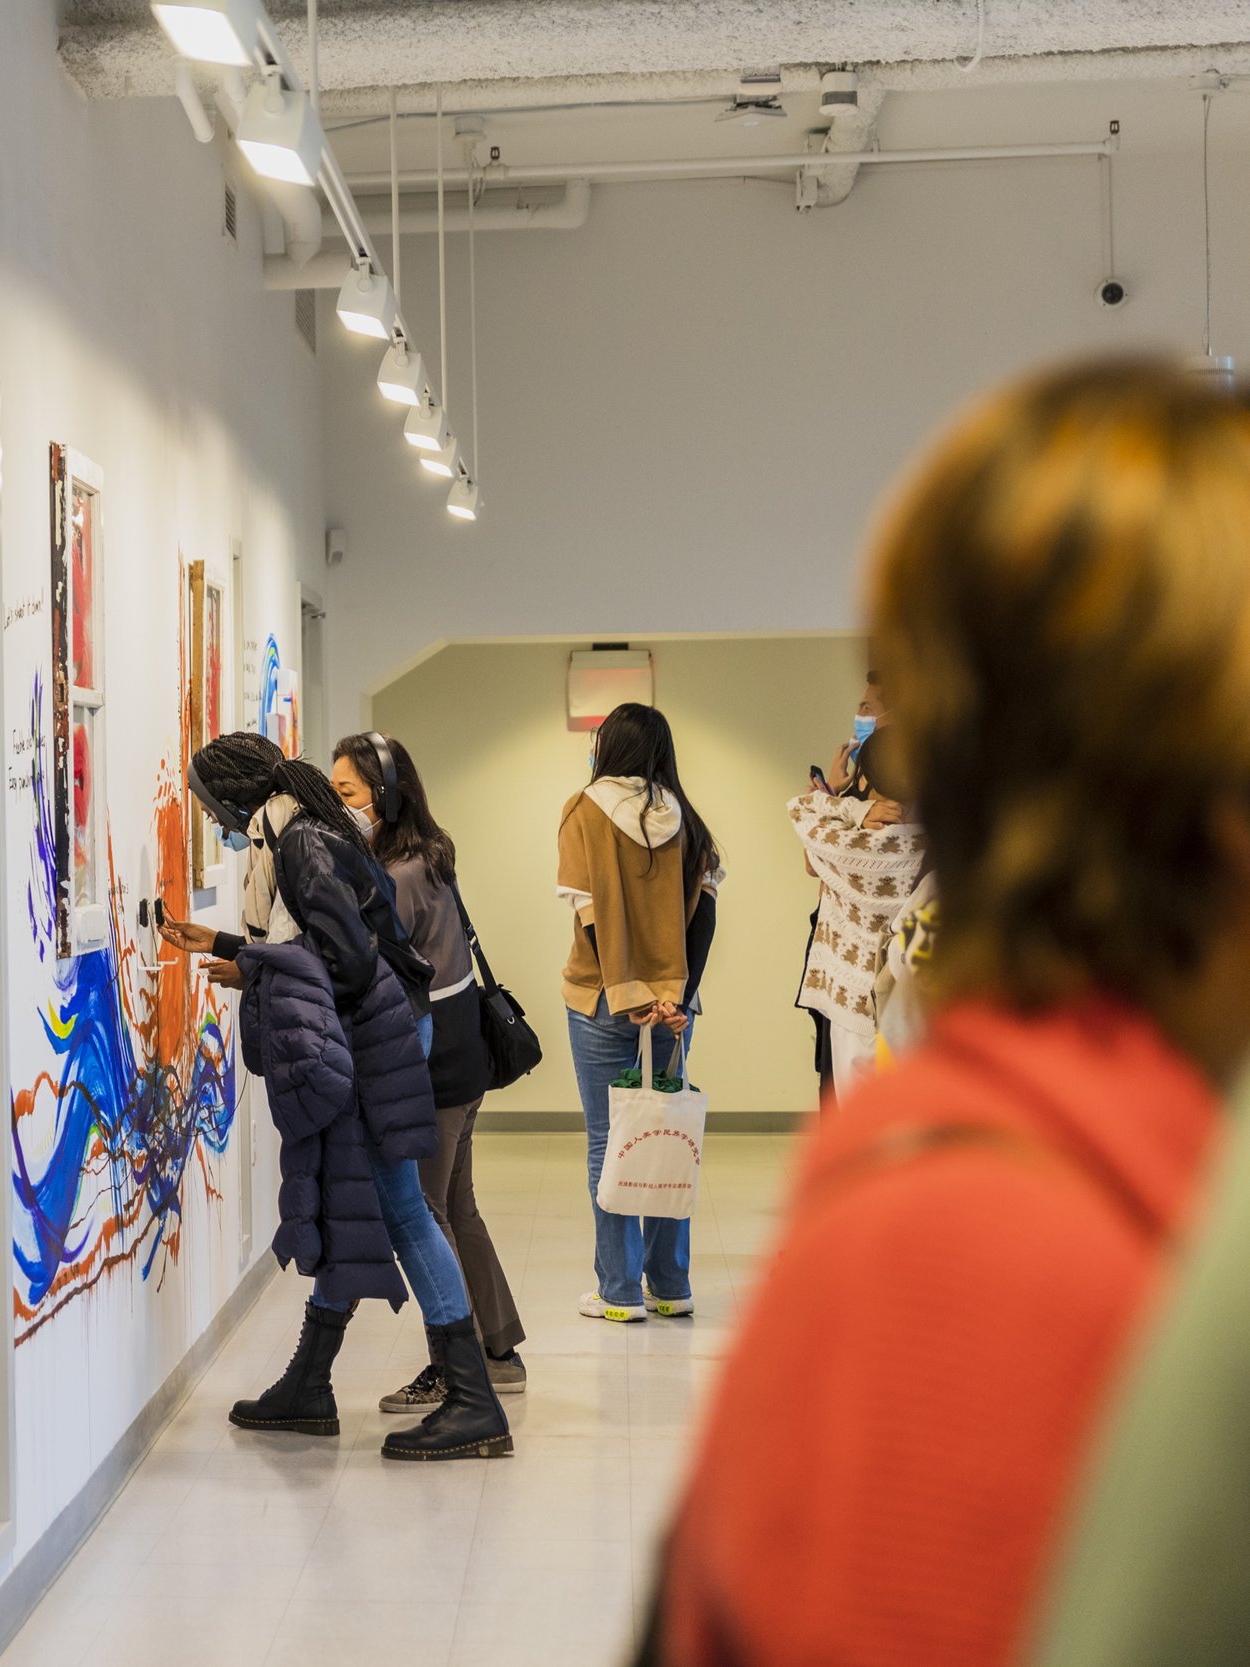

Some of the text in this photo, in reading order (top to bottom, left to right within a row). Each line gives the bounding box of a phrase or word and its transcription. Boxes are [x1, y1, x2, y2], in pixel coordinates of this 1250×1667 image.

[618, 1129, 700, 1166] 中国人类学民族学研究会
